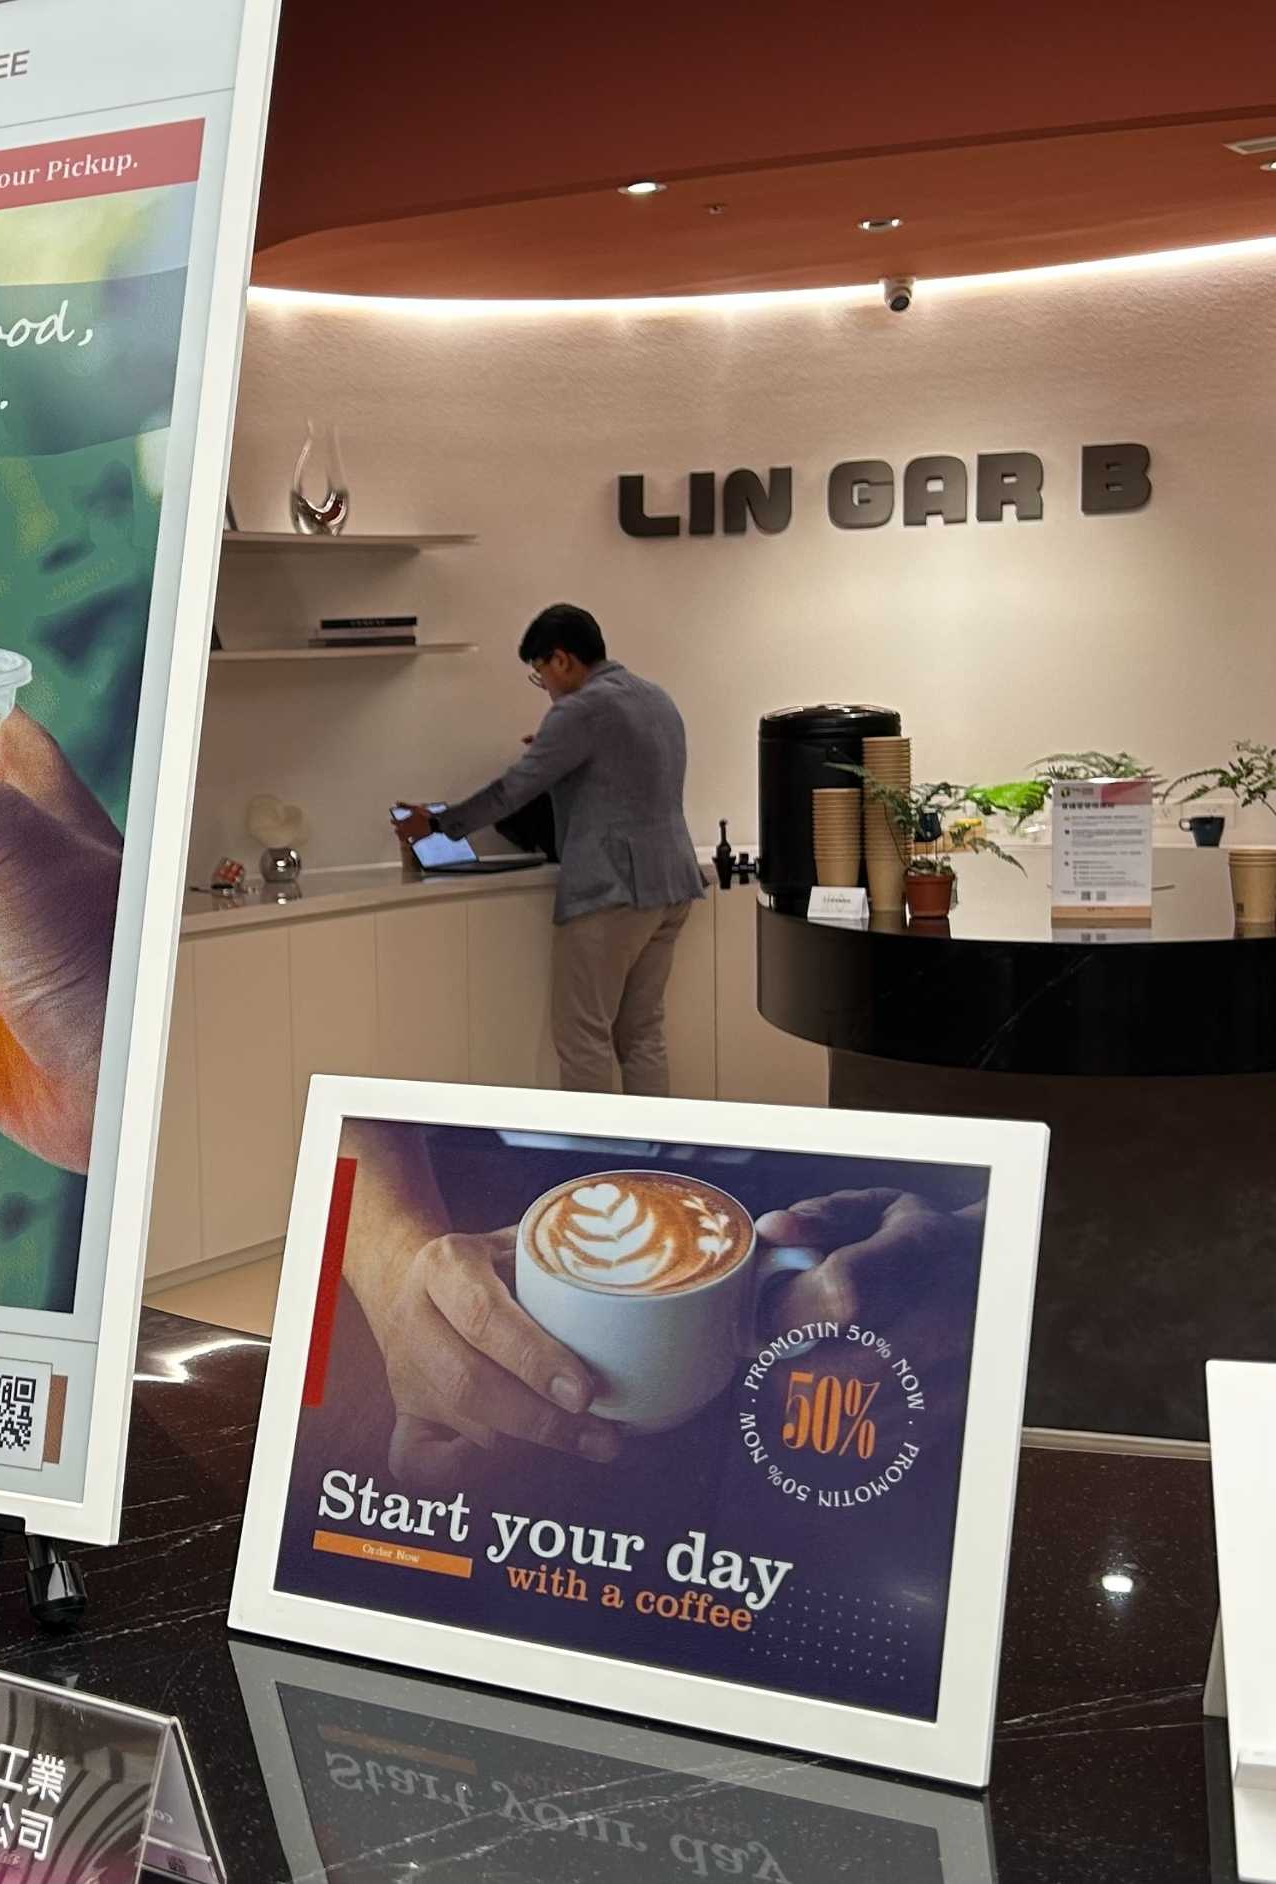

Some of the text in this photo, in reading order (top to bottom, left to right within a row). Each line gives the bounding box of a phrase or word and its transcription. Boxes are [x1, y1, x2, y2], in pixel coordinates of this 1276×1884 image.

[46, 152, 139, 182] Pickup.
[617, 443, 1153, 538] LIN GAR B
[744, 1321, 925, 1411] PROMOTIN 50% NOW
[781, 1370, 881, 1460] 50%
[318, 1469, 794, 1611] Start your day
[362, 1543, 421, 1563] Order Now
[506, 1562, 753, 1633] with a coffee
